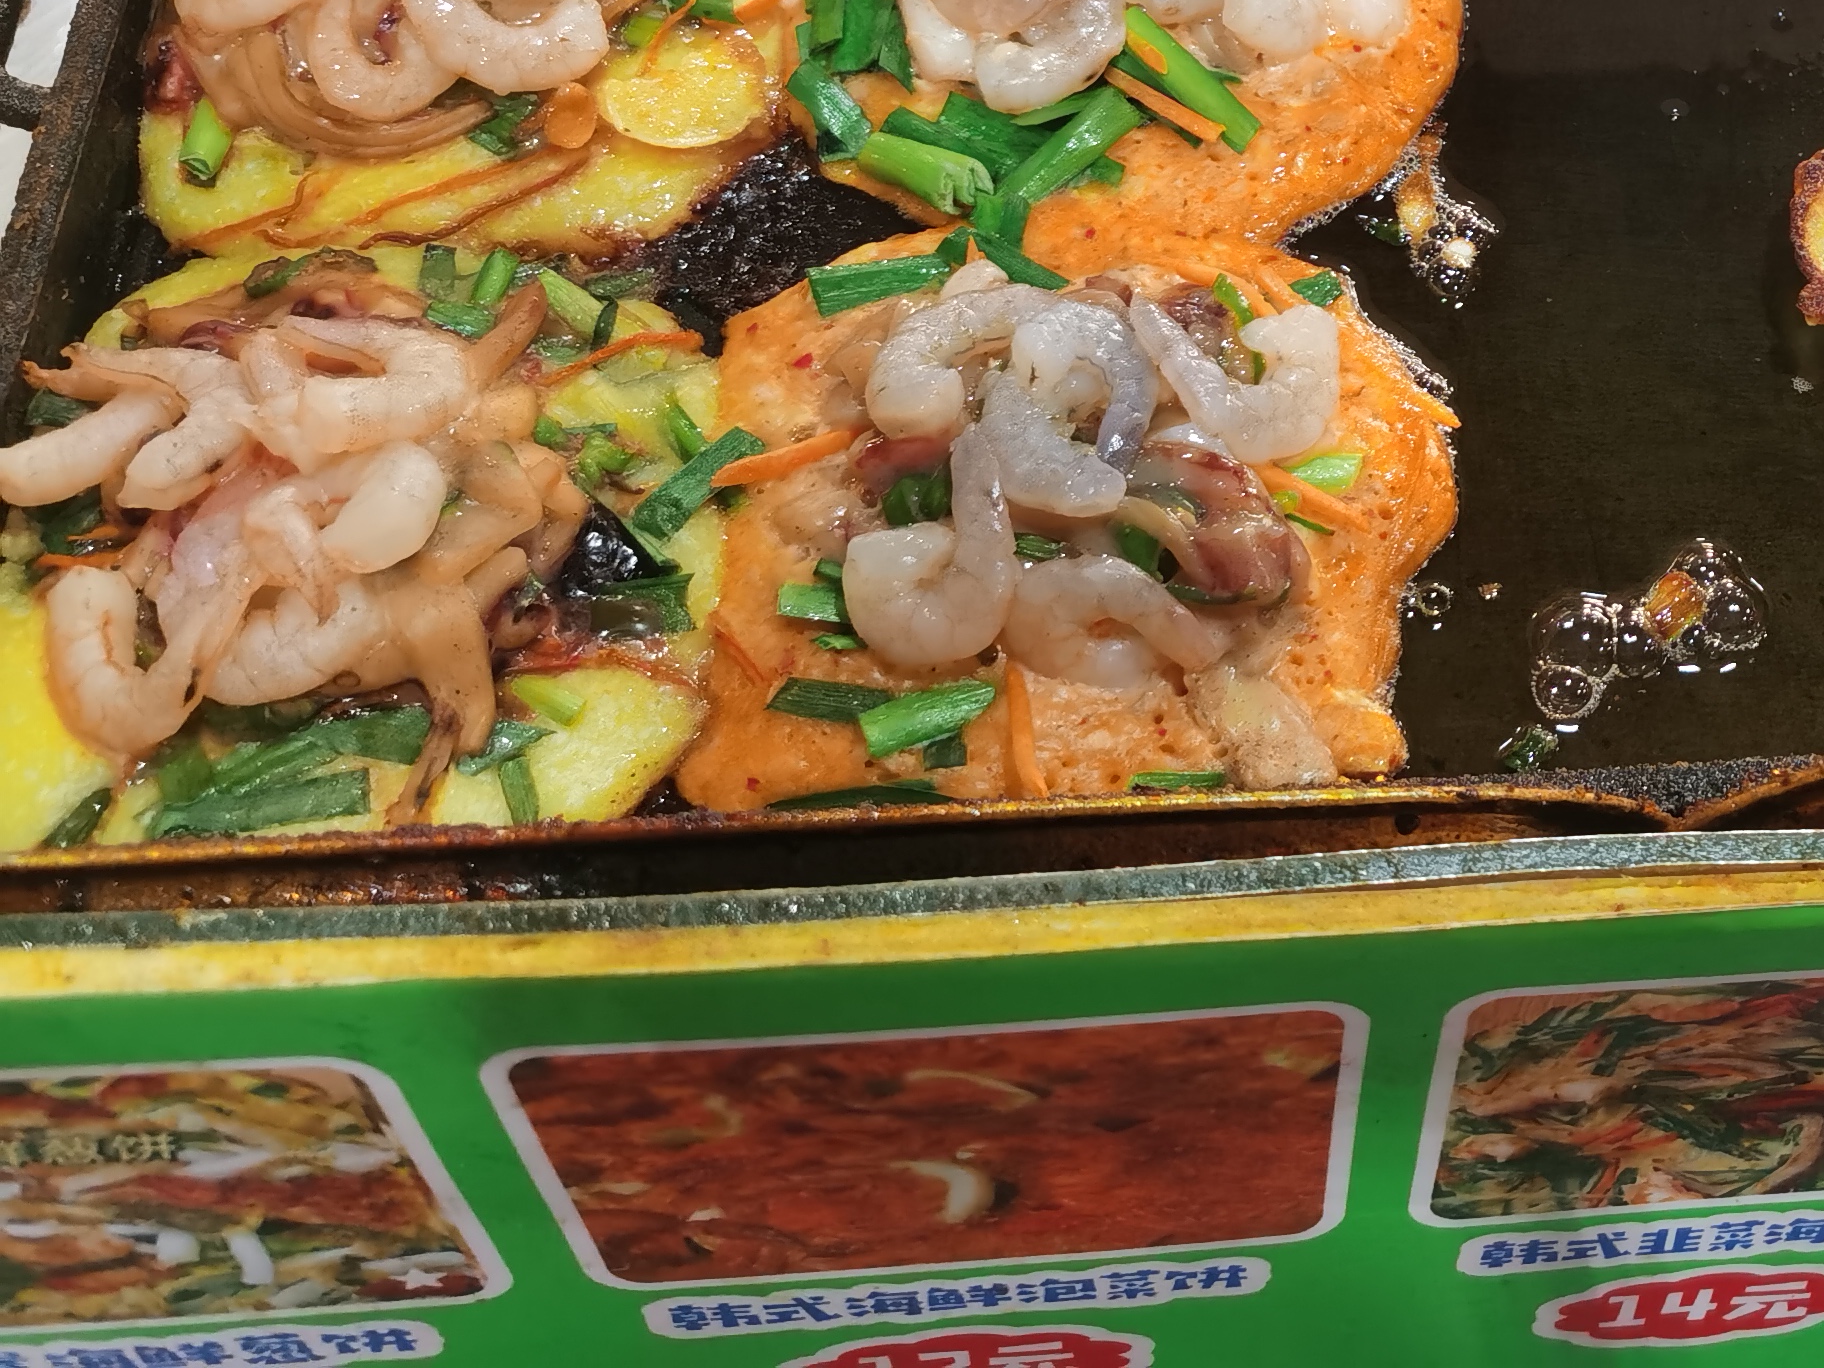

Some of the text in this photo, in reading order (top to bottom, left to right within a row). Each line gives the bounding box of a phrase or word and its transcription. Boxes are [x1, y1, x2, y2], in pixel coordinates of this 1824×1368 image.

[667, 1263, 1249, 1331] 韩式海鲜泡菜饼
[1598, 1279, 1812, 1330] 14元
